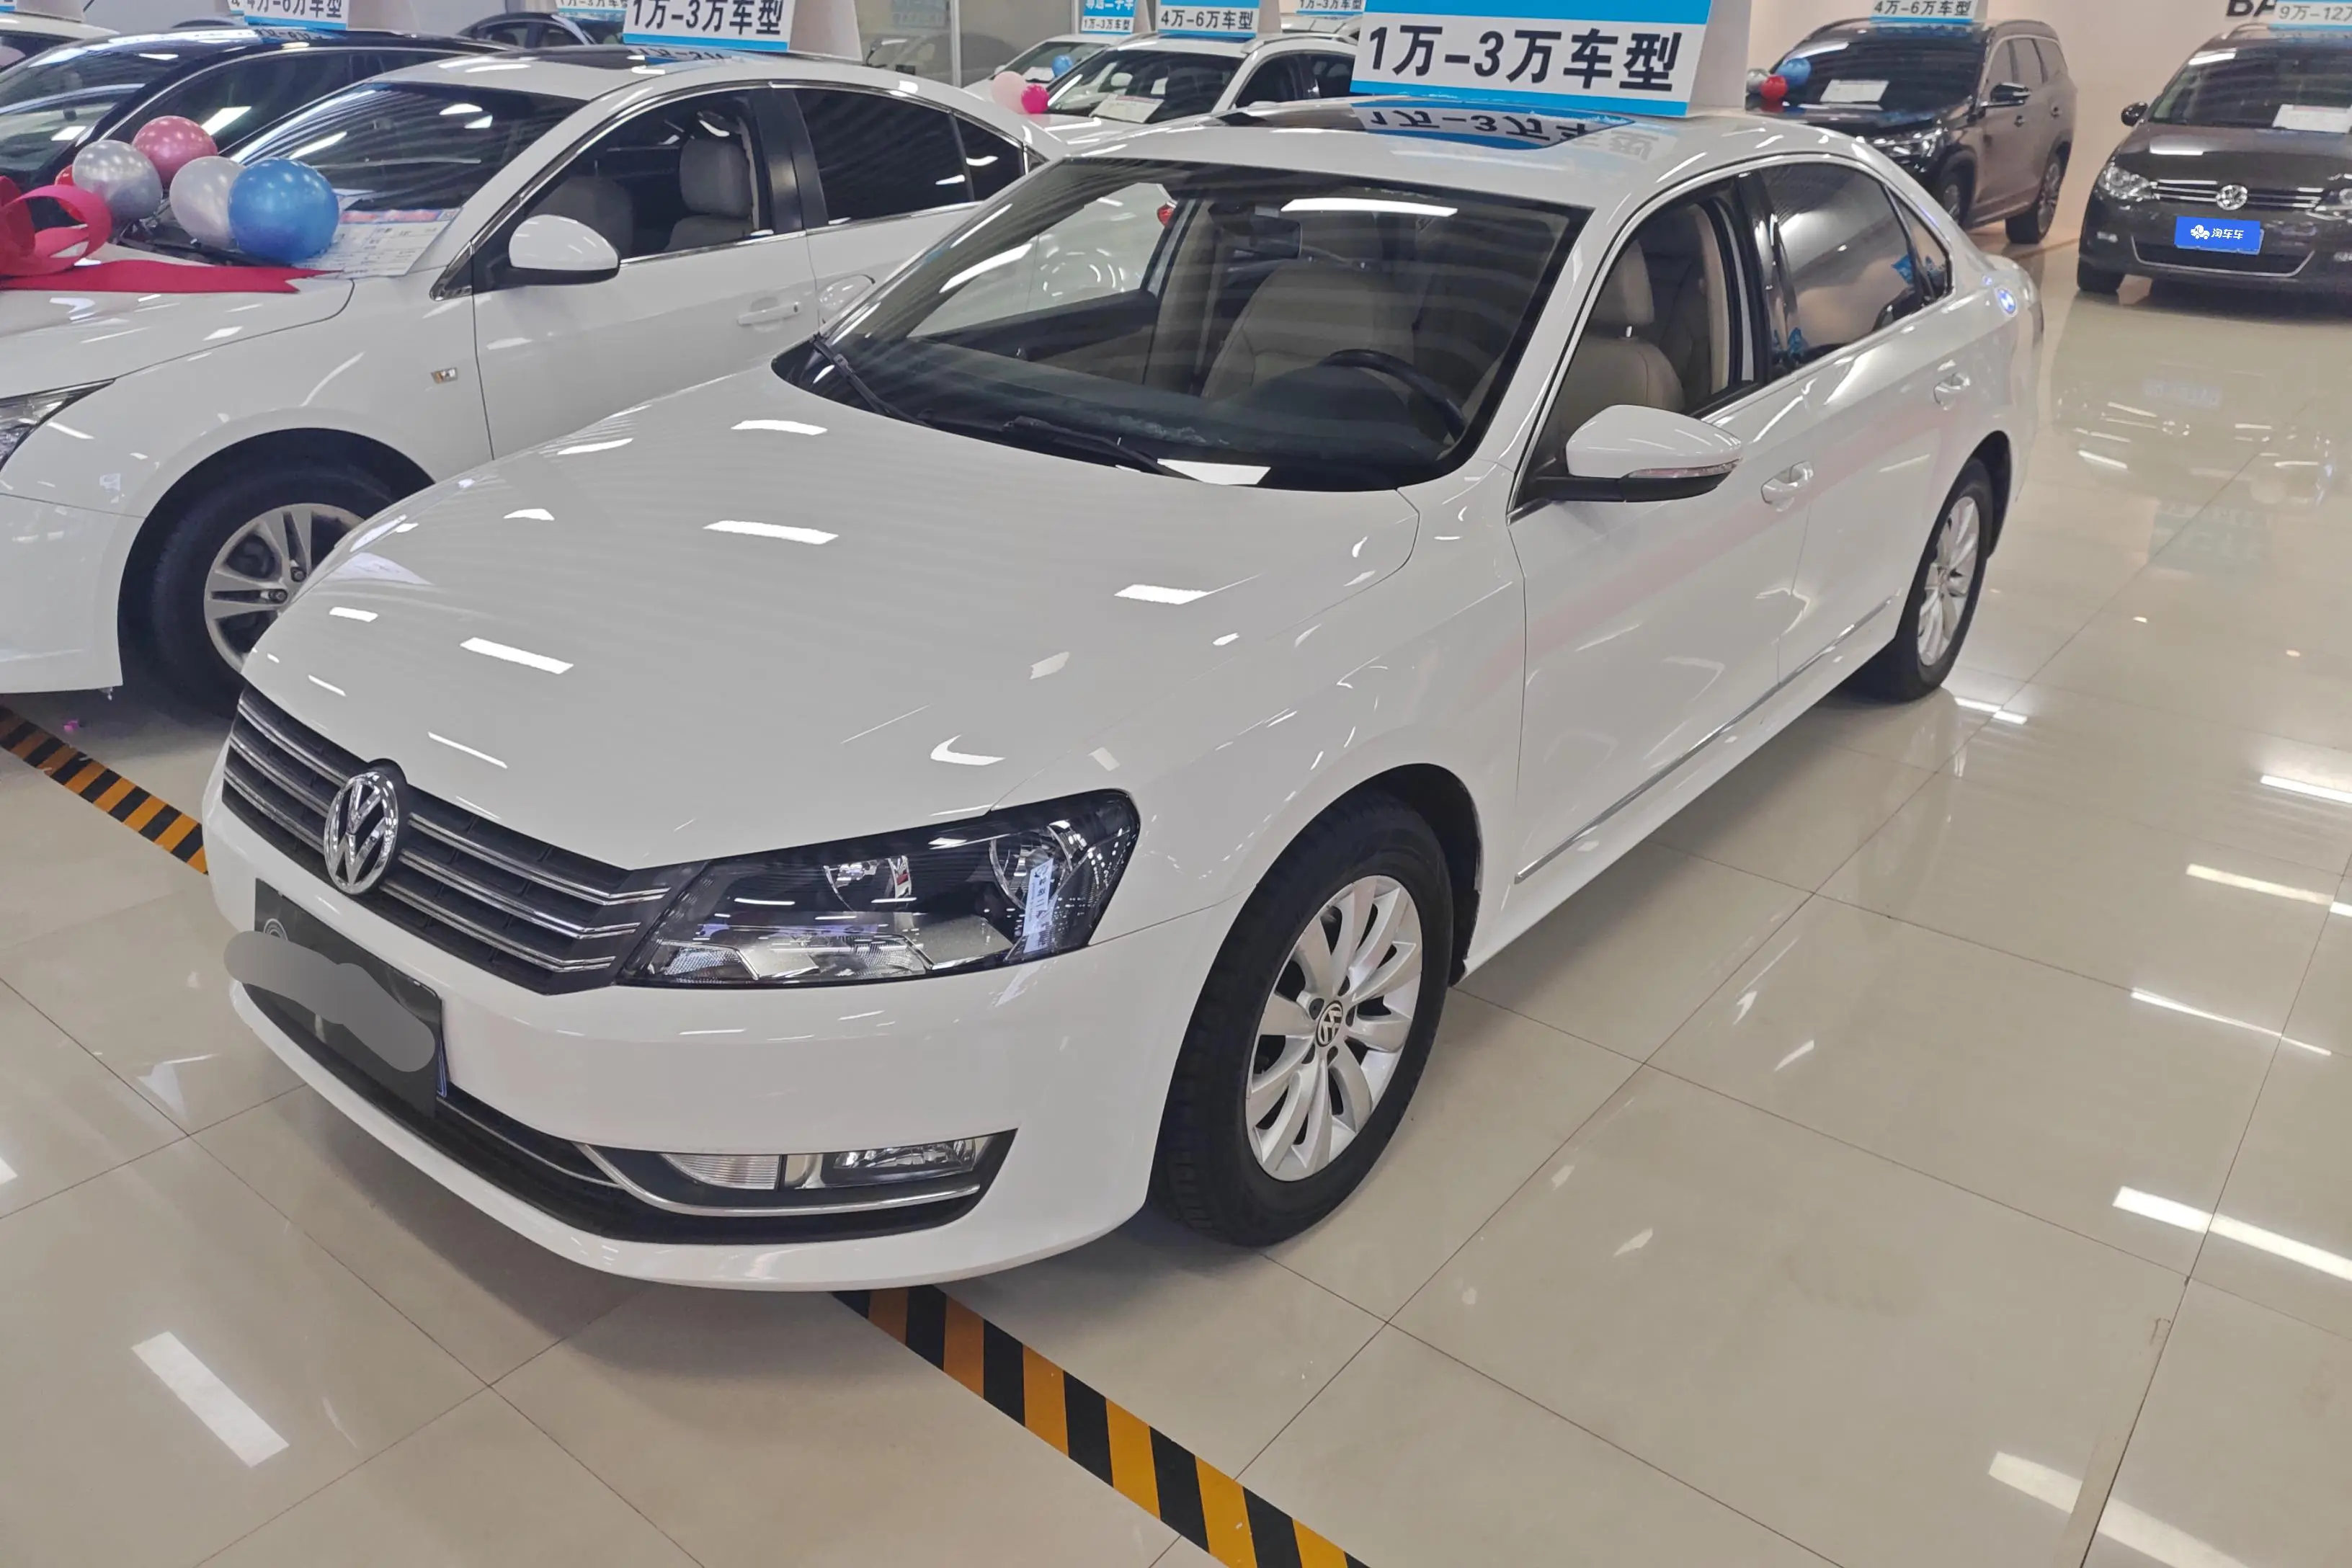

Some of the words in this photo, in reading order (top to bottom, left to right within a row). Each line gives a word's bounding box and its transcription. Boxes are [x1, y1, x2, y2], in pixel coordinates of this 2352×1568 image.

[633, 0, 783, 35] 1万-3万车型
[1161, 10, 1253, 30] 4万-6万车型
[1874, 0, 1972, 16] 4万-6万车型
[1370, 24, 1683, 92] 1万-3万车型
